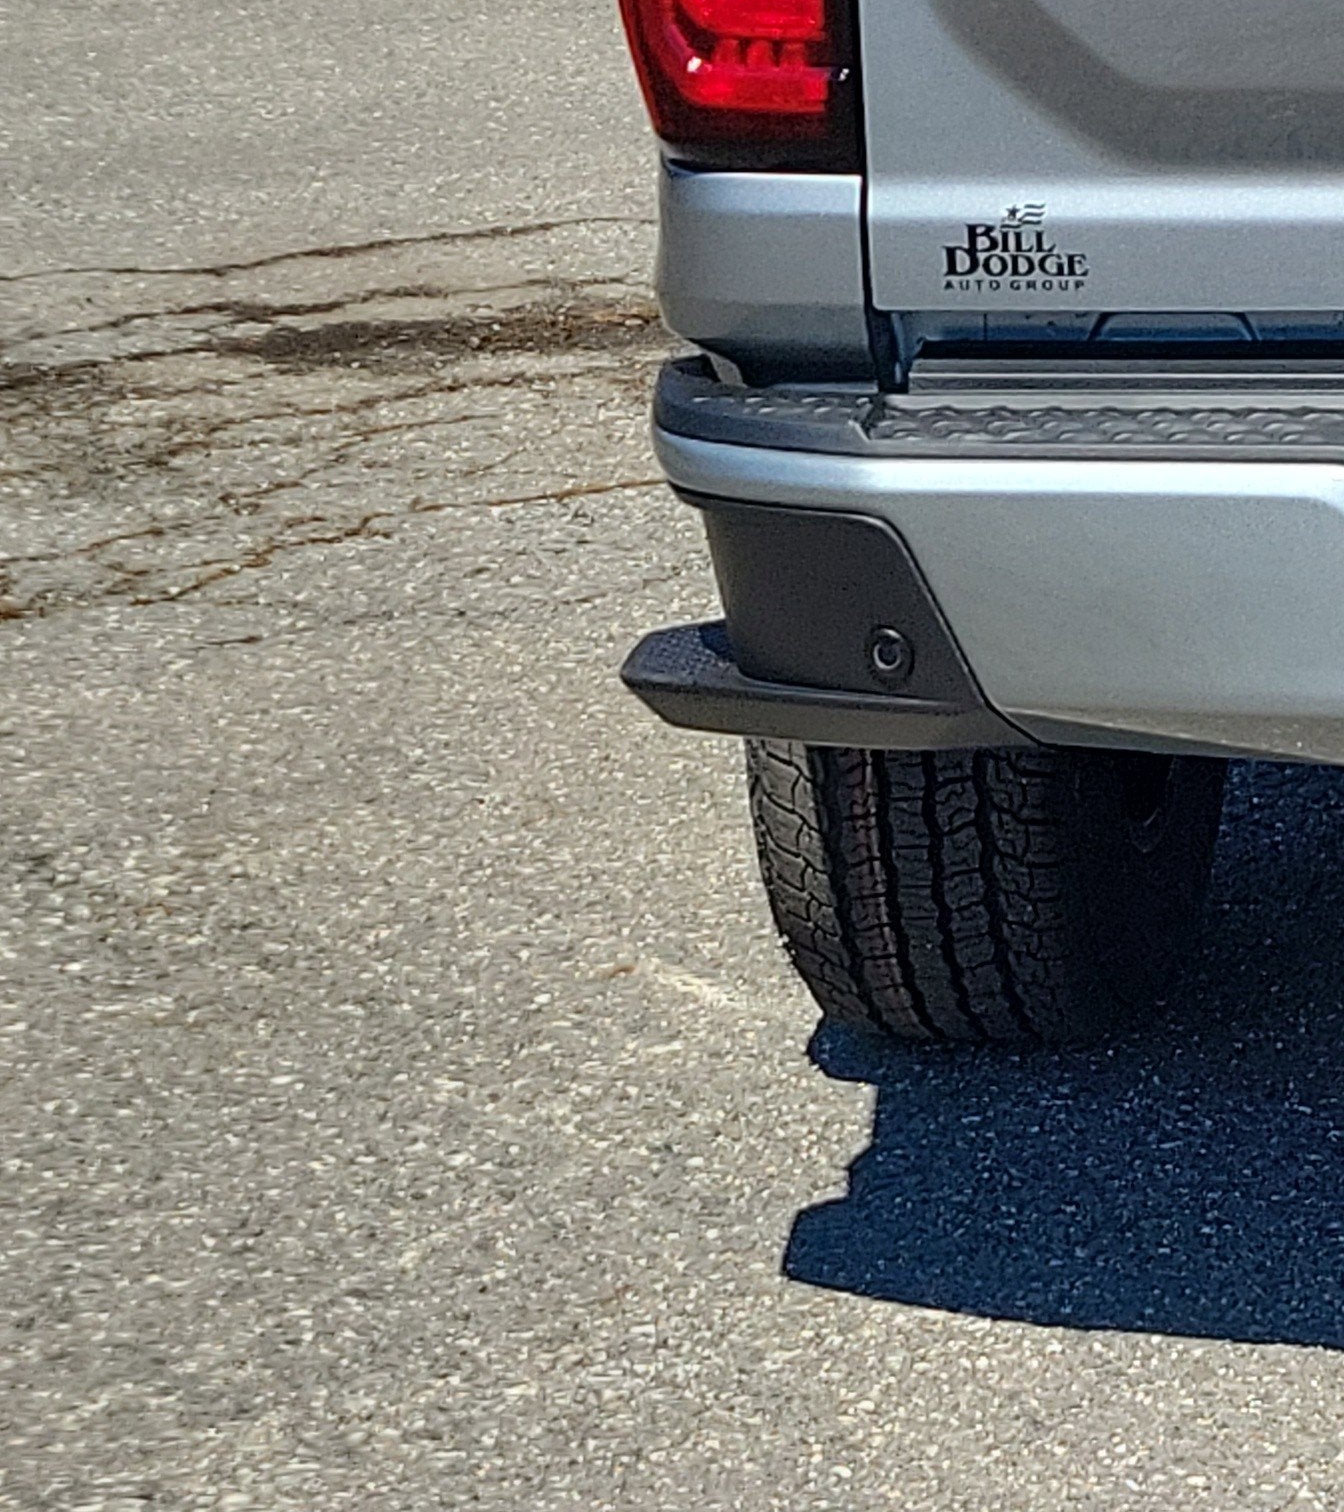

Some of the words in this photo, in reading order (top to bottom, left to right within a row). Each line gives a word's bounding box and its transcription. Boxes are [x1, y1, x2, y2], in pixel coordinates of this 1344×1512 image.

[965, 223, 1056, 253] BILL
[943, 245, 1088, 276] DODGE
[943, 279, 1000, 291] AUTO
[1009, 279, 1085, 291] GROUP
